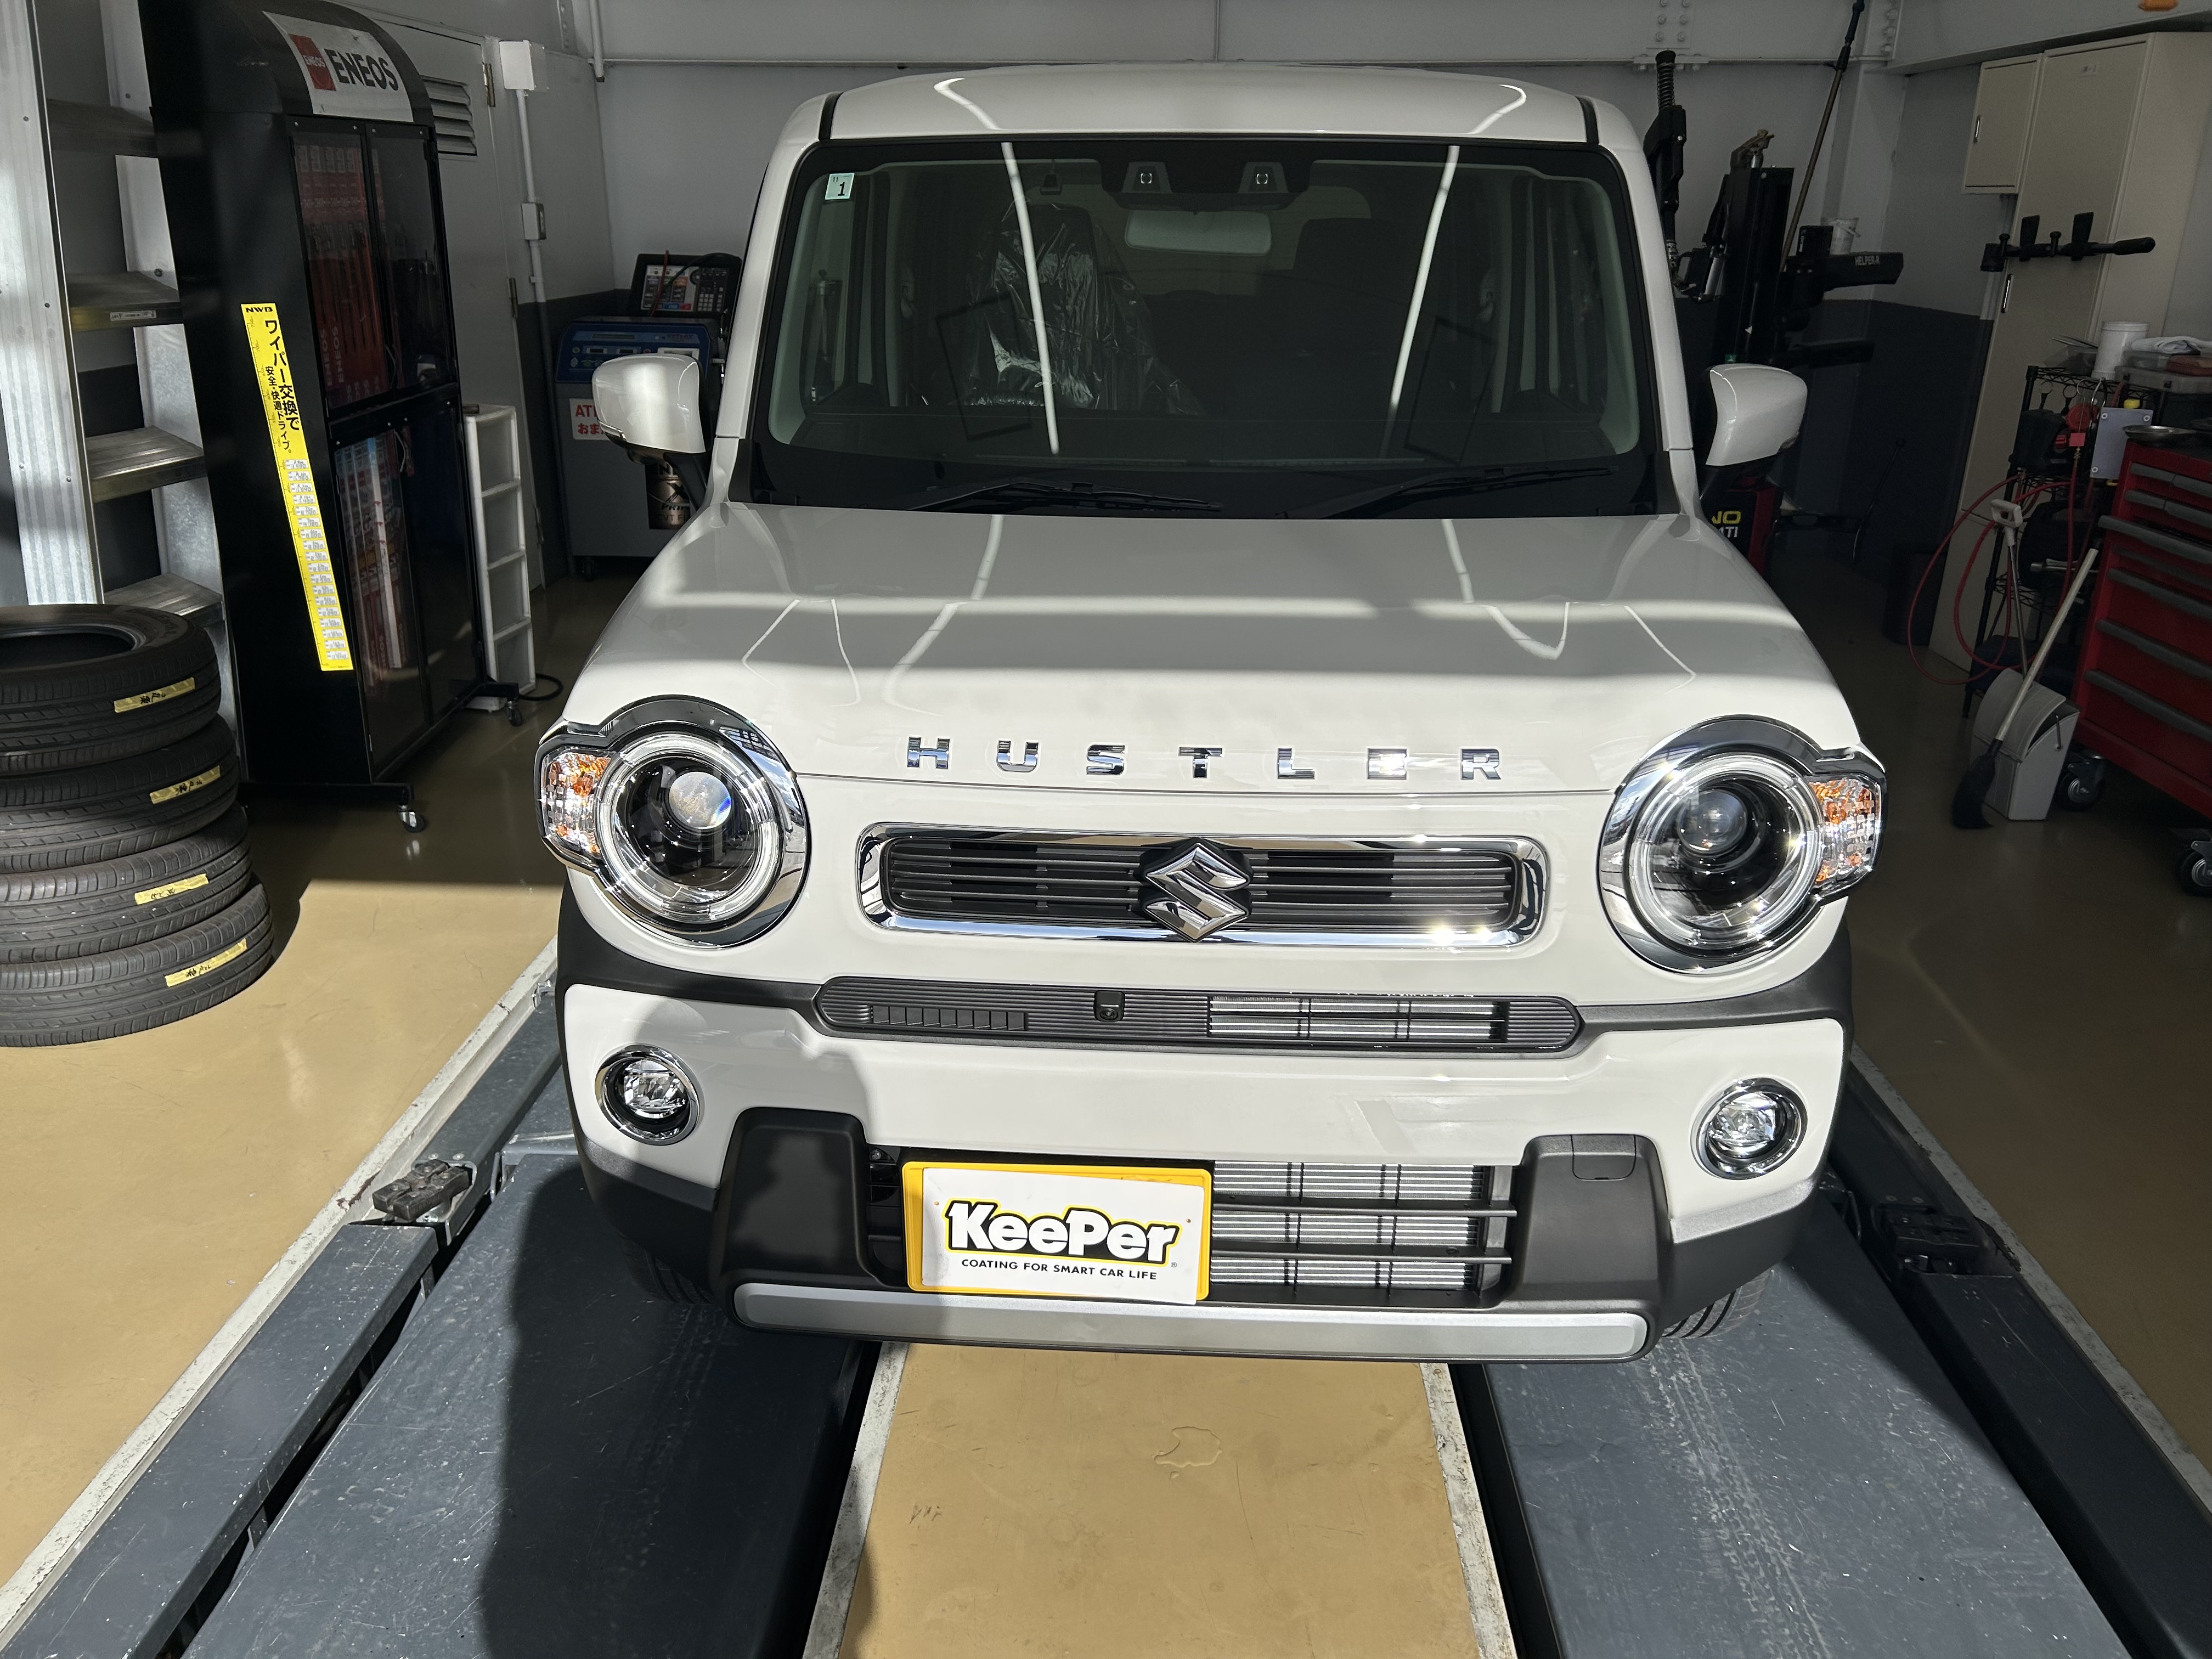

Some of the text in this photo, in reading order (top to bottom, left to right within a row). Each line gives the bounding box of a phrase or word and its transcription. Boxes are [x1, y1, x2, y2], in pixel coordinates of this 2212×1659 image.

[303, 56, 327, 67] ENEOS
[324, 48, 399, 91] ENEOS
[838, 182, 845, 196] 1
[332, 326, 344, 382] ENEOS
[264, 319, 300, 431] ワイパー交換で
[575, 404, 597, 417] AT
[578, 423, 605, 435] おま
[906, 736, 1501, 781] HUSTLER
[946, 1201, 1179, 1264] KeePer
[962, 1259, 1157, 1280] COATING FOR SMART CAR LIFE
